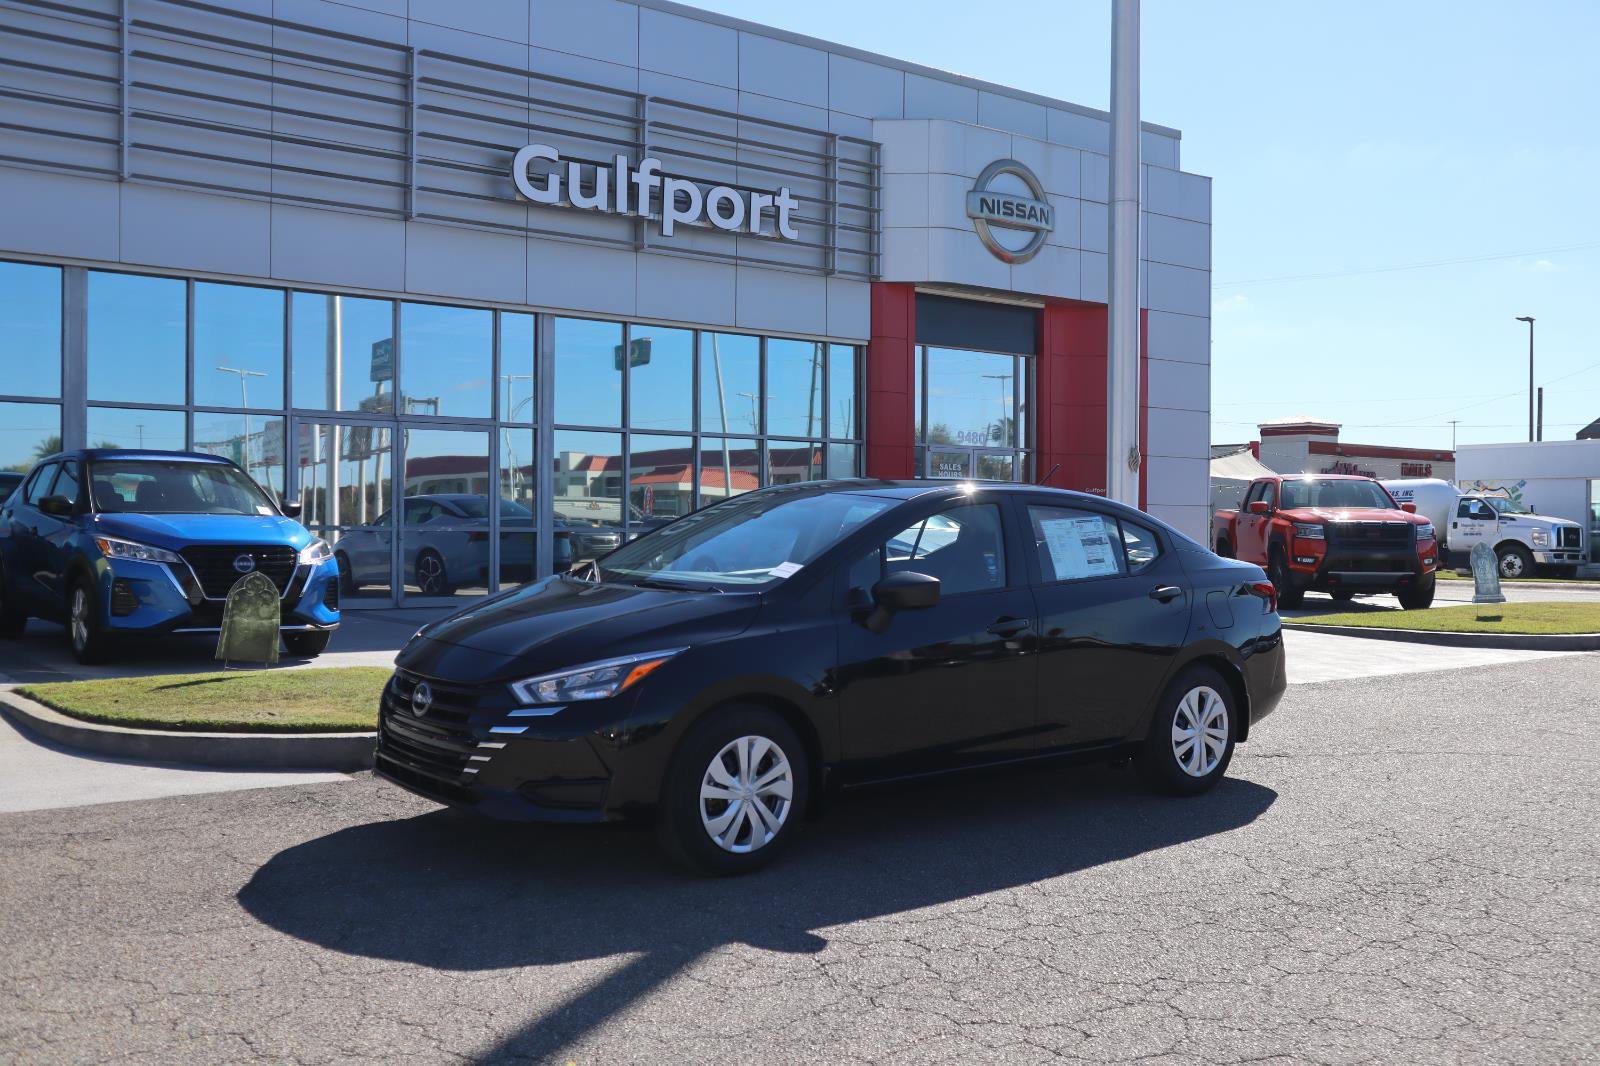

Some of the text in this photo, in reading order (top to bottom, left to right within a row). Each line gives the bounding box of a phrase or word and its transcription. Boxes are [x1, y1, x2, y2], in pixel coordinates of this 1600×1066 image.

[512, 143, 799, 240] Gulfport
[980, 197, 1050, 225] NISSAN
[957, 430, 985, 445] 9480
[939, 463, 962, 471] SALES
[938, 471, 962, 479] HOURS
